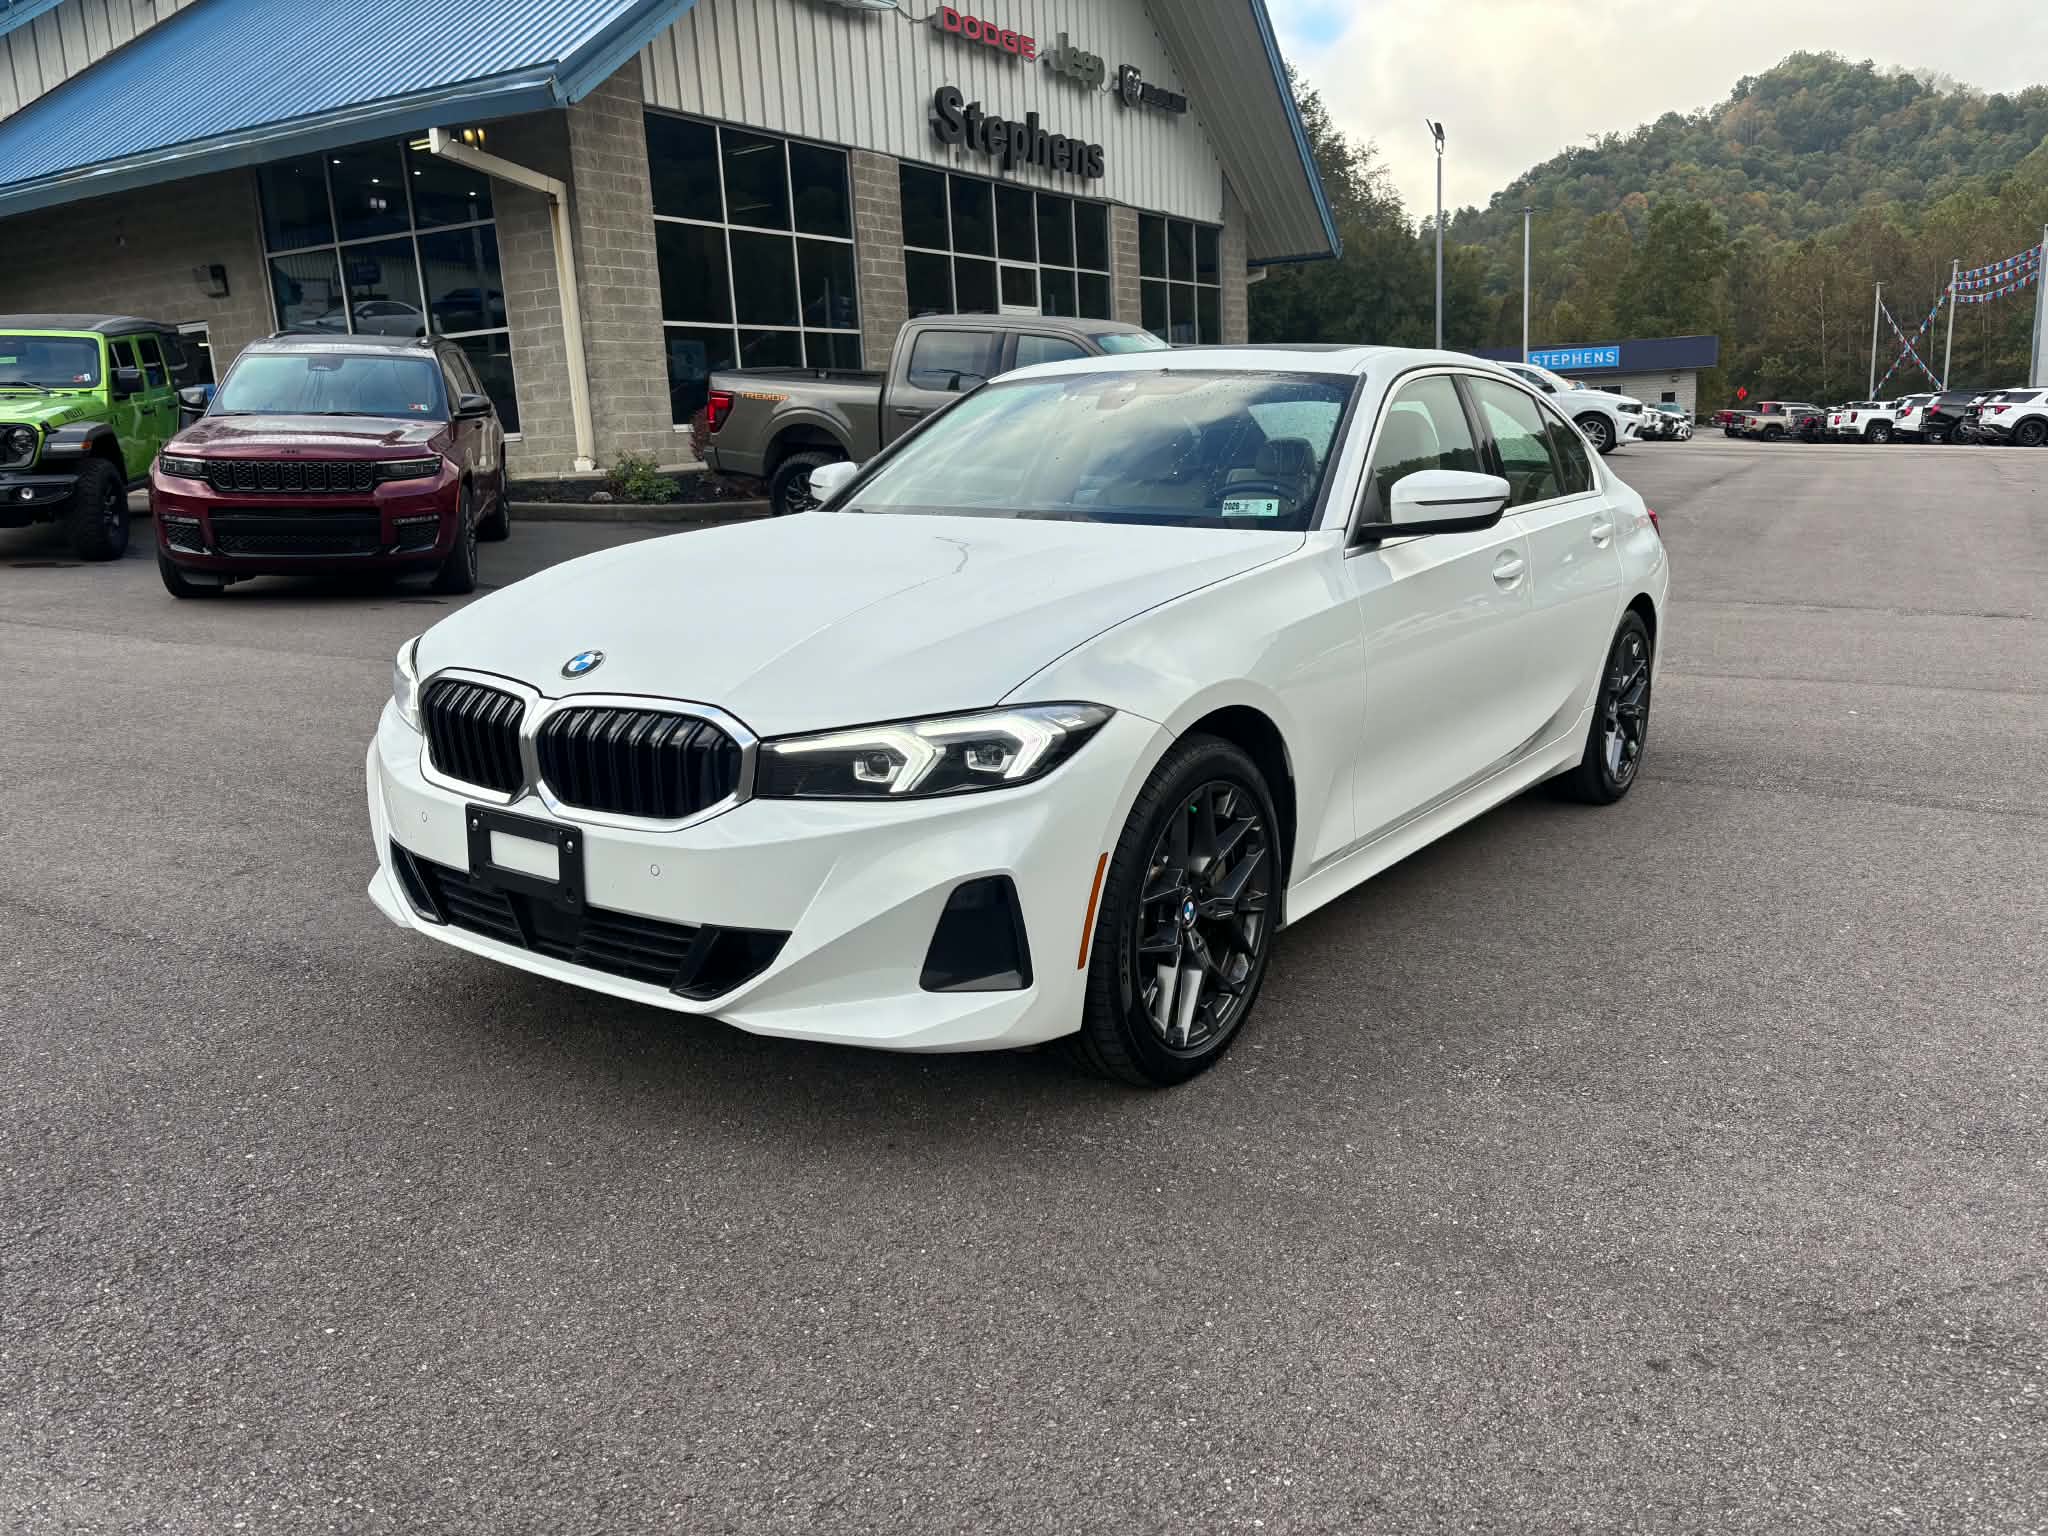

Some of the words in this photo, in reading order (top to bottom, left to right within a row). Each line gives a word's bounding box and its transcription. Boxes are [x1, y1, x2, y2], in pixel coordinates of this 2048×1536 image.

[940, 6, 1037, 62] DODGE
[934, 86, 1105, 178] Stephens
[1532, 351, 1616, 366] STEPHENS
[741, 392, 789, 400] TREMOR
